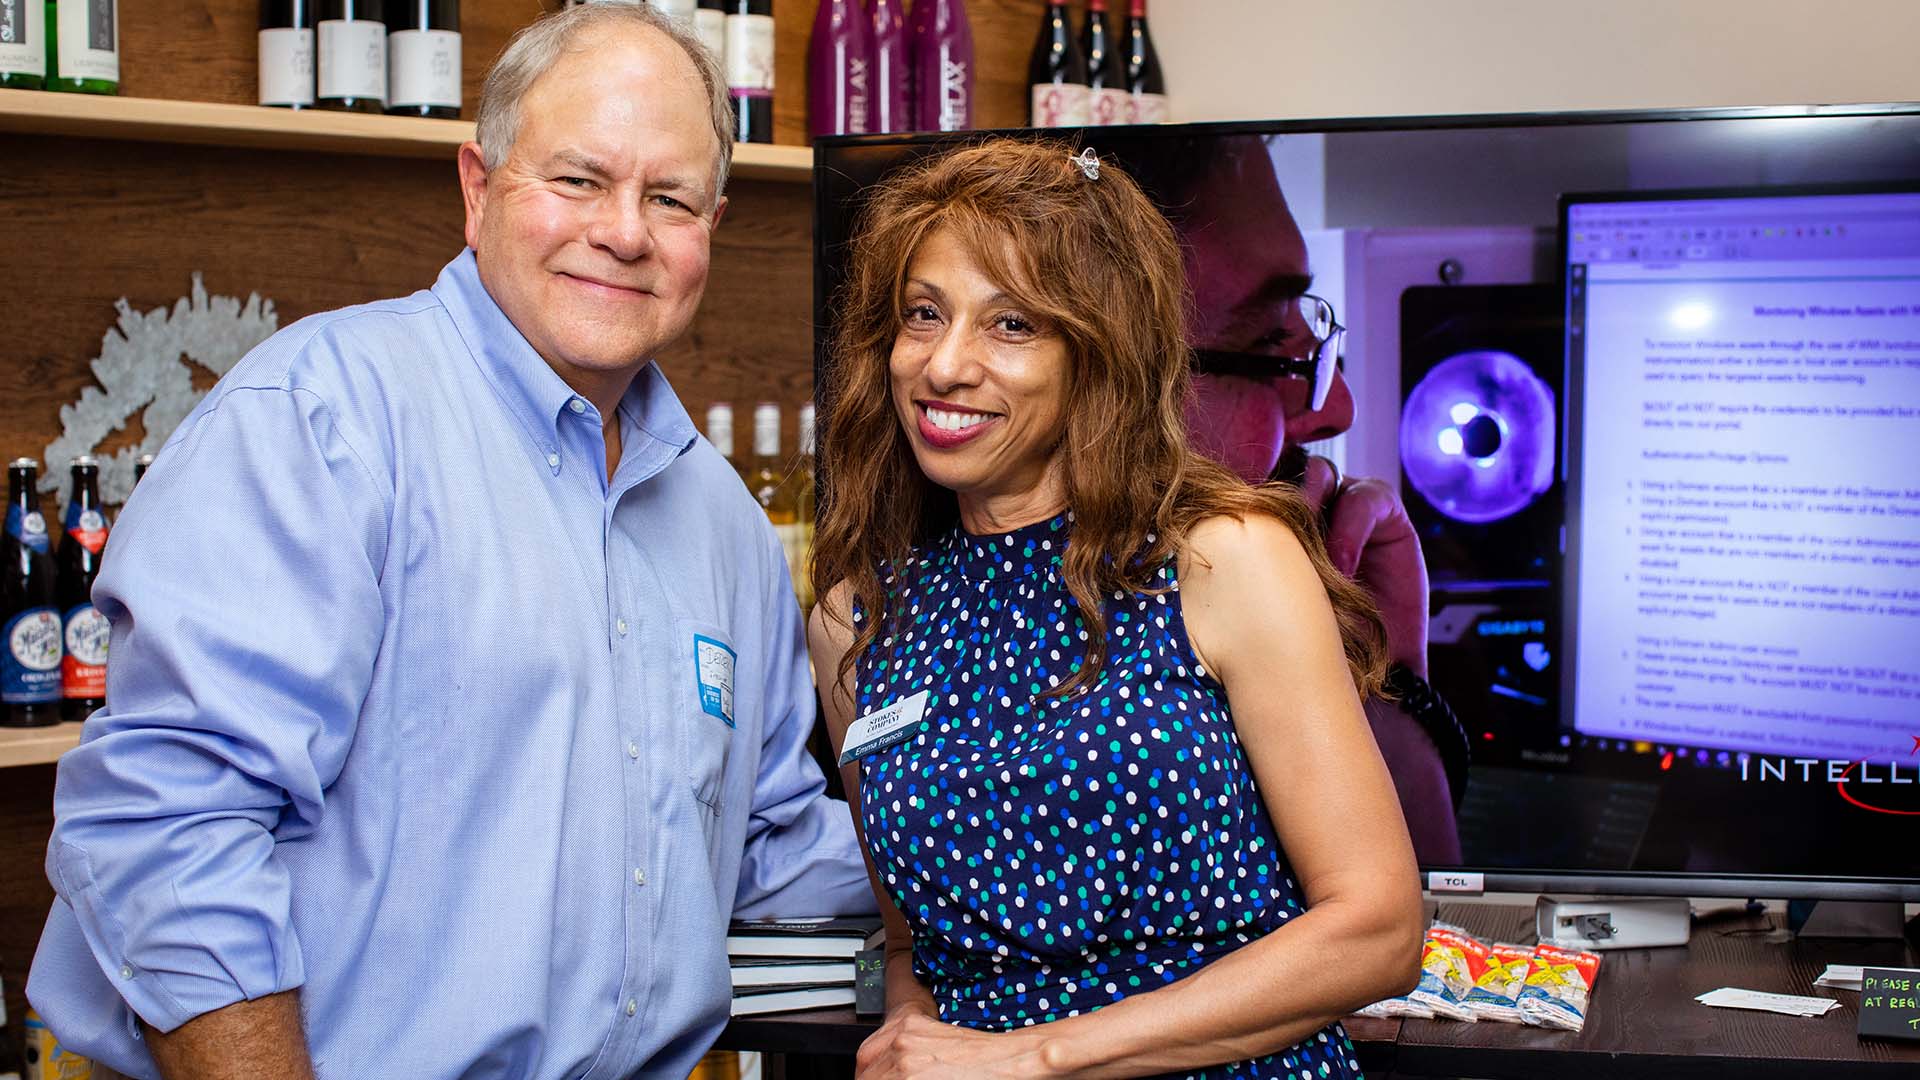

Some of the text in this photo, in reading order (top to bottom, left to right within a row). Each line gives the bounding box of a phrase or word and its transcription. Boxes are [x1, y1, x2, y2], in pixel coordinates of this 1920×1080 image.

[855, 742, 877, 756] Emma
[879, 730, 904, 746] Francis
[1741, 759, 1920, 784] INTELL
[1445, 878, 1468, 887] TCL
[1864, 996, 1883, 1007] AT
